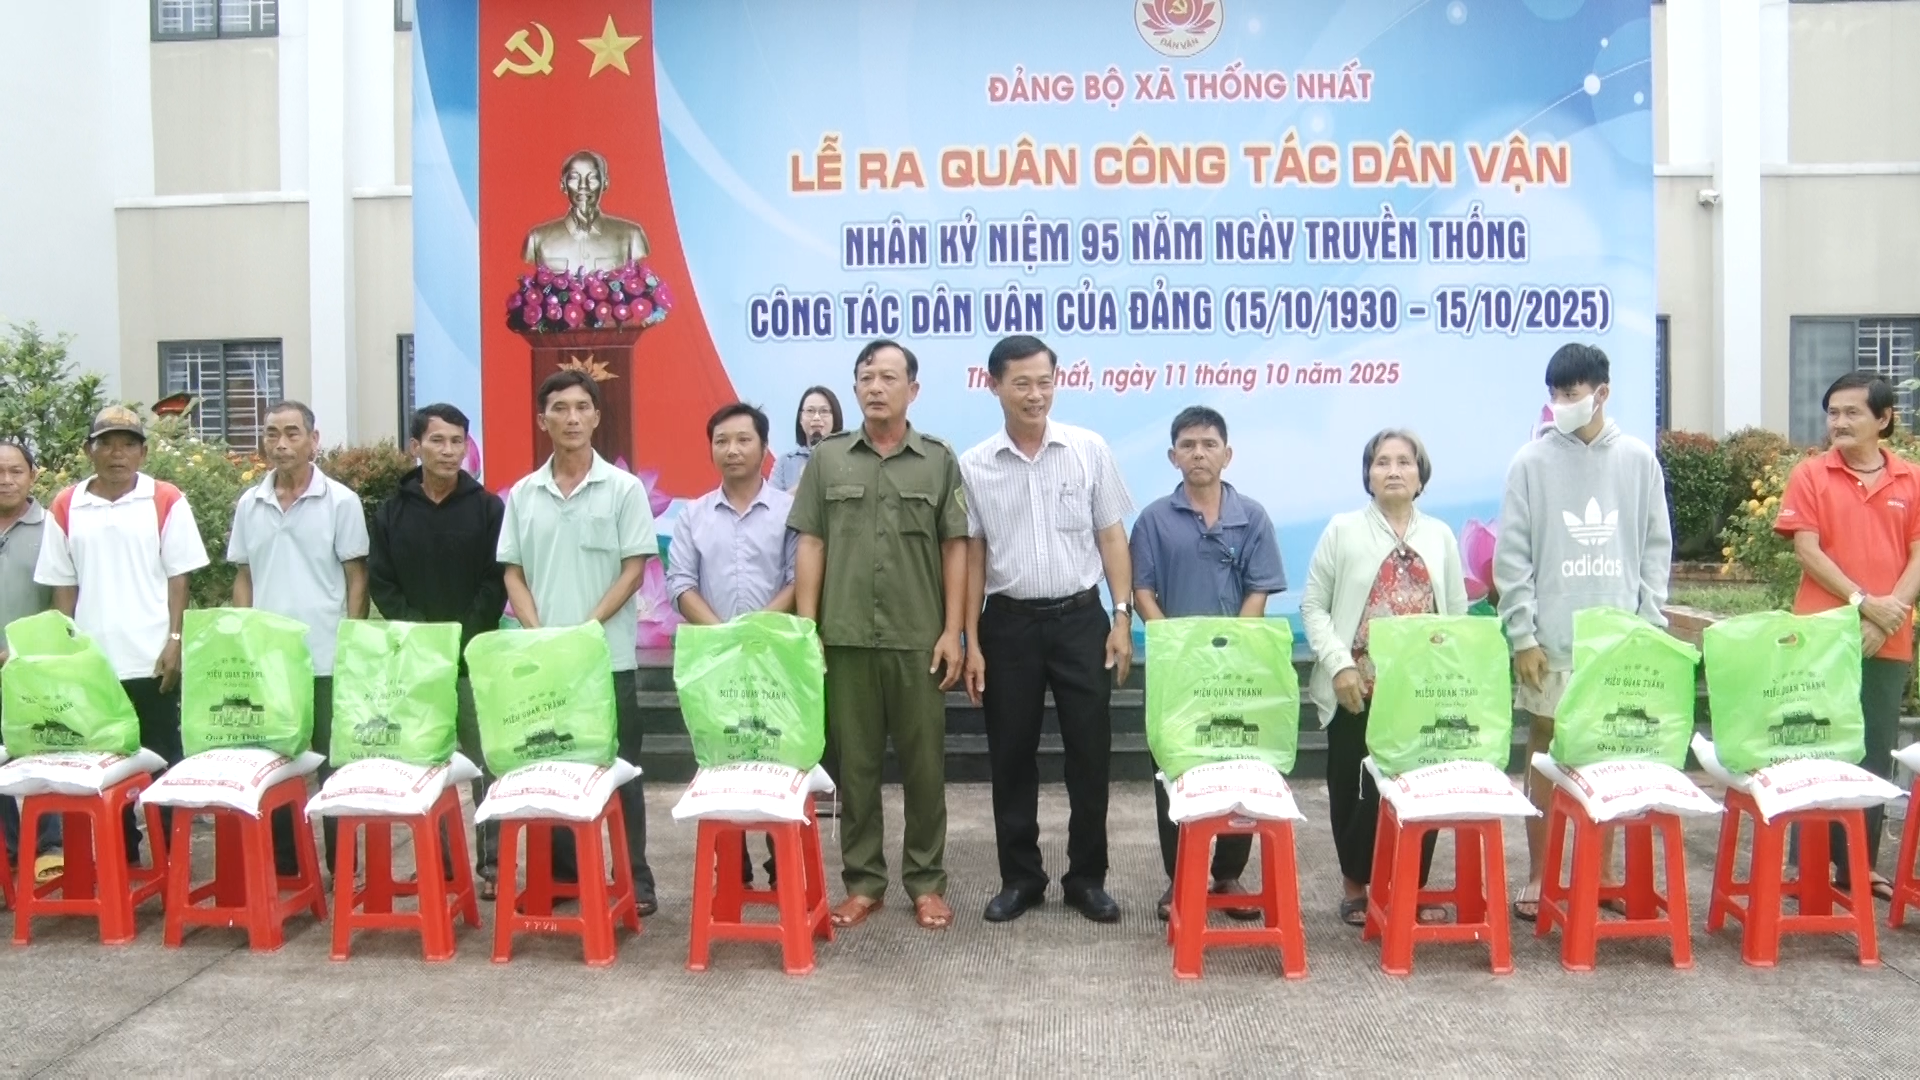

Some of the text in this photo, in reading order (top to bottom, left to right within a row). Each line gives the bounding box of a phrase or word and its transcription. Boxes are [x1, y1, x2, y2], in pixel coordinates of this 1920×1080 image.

[988, 61, 1372, 108] ĐẢNG BỘ XÃ THỐNG NHẤT
[791, 131, 1568, 193] LỄ RA QUÂN CÔNG TÁC DÂN VẬN
[845, 204, 1526, 271] NHÂN KỶ NIỆM 95 NĂM NGÀY TRUYỀN THỐNG
[751, 290, 832, 338] CÔNG
[843, 288, 900, 334] TÁC
[912, 286, 972, 334] DÂN
[1056, 279, 1117, 332] CỦA
[1129, 279, 1212, 332] ĐẢNG
[1225, 289, 1397, 334] (15/10/1930
[1436, 289, 1610, 333] 15/10/2025)
[1054, 360, 1400, 393] hất, ngày 11 tháng 10 năm 2025
[1561, 554, 1622, 577] adidas
